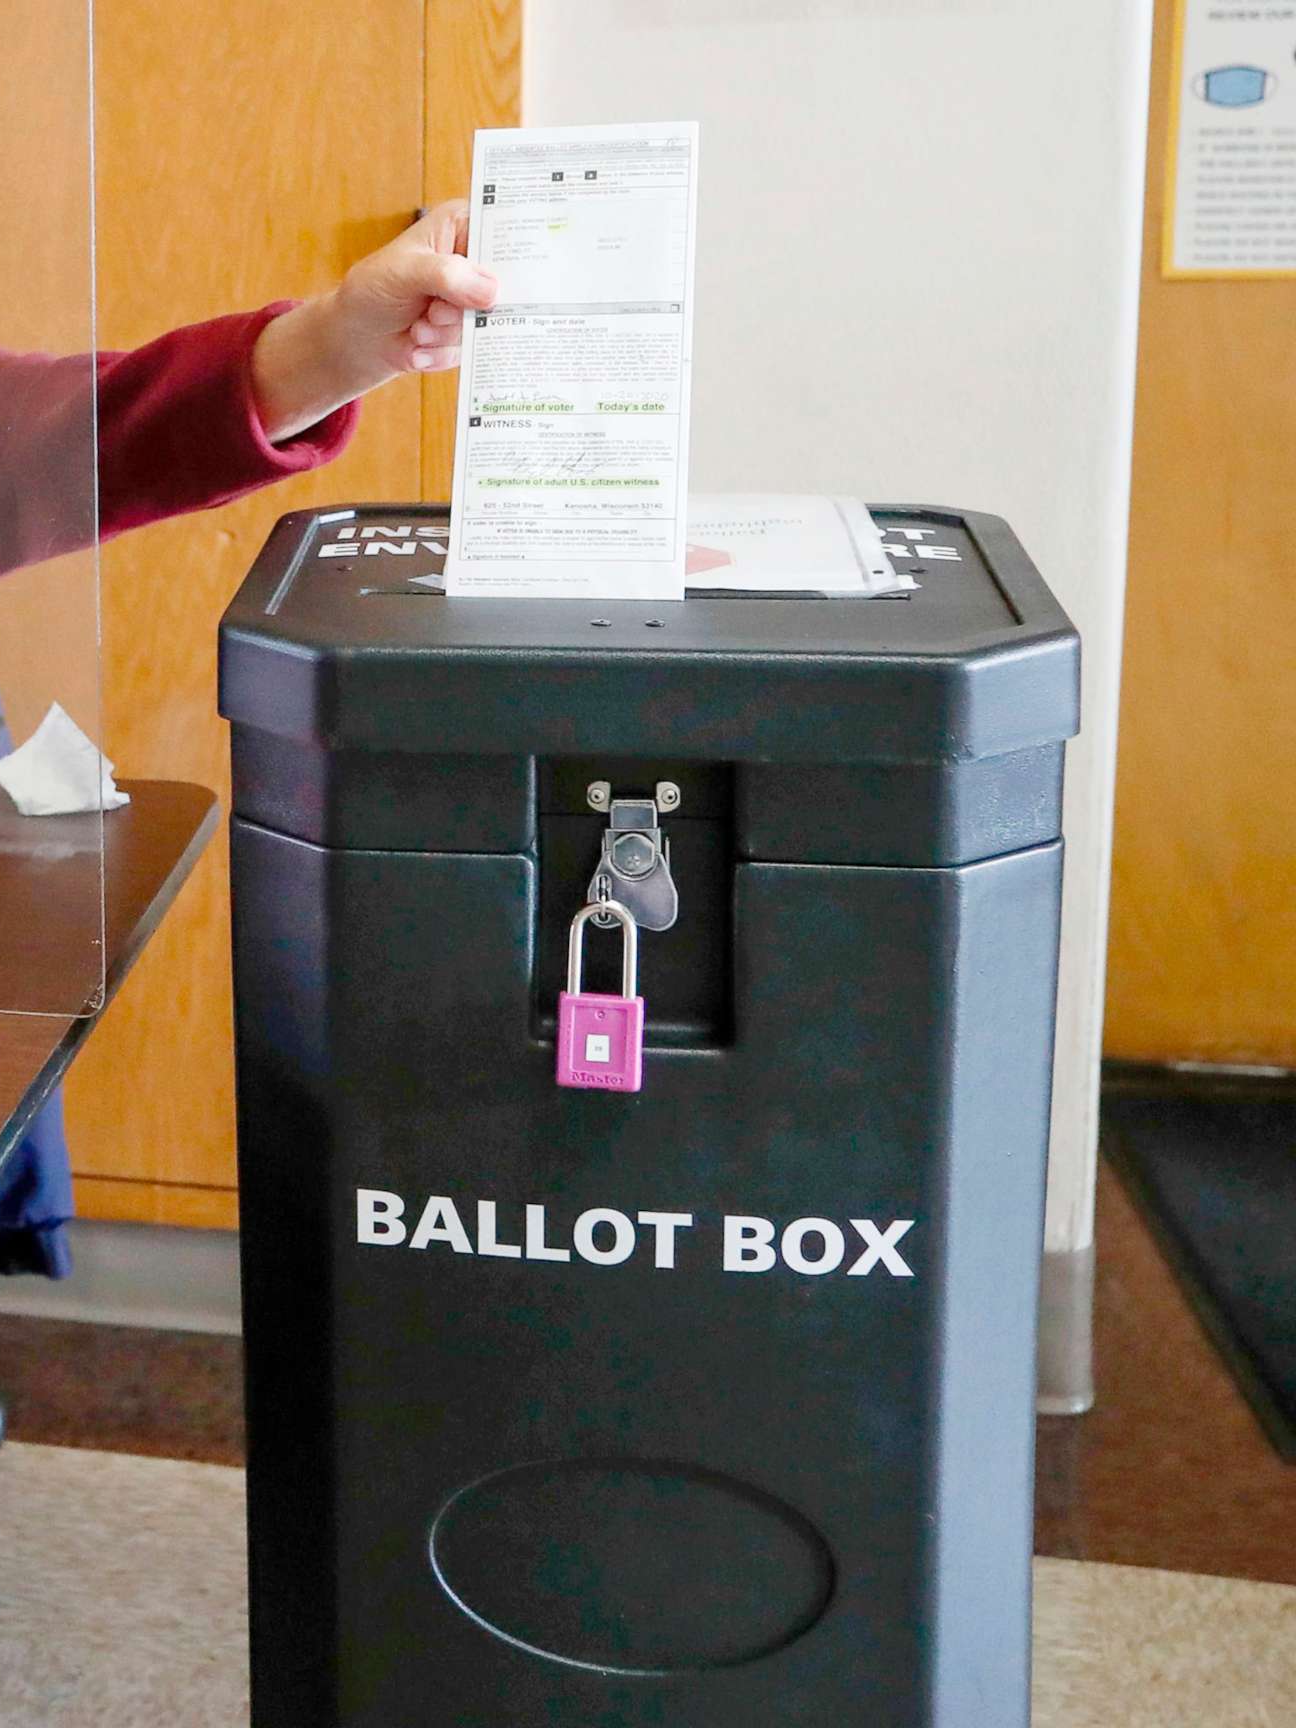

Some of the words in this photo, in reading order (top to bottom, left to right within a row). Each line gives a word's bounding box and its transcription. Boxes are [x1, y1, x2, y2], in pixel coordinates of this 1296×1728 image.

[489, 317, 526, 326] VOTER
[482, 403, 532, 412] Signature
[534, 403, 546, 411] of
[598, 402, 639, 412] Today's
[641, 403, 665, 411] date
[483, 419, 532, 428] WITNESS
[487, 477, 532, 486] Signature
[534, 477, 543, 486] of
[543, 478, 569, 486] adult
[570, 478, 589, 486] U.S.
[591, 478, 622, 486] citizen
[623, 478, 660, 486] witness
[571, 1071, 624, 1085] Master
[356, 1187, 694, 1269] BALLOT
[722, 1214, 916, 1278] BOX
